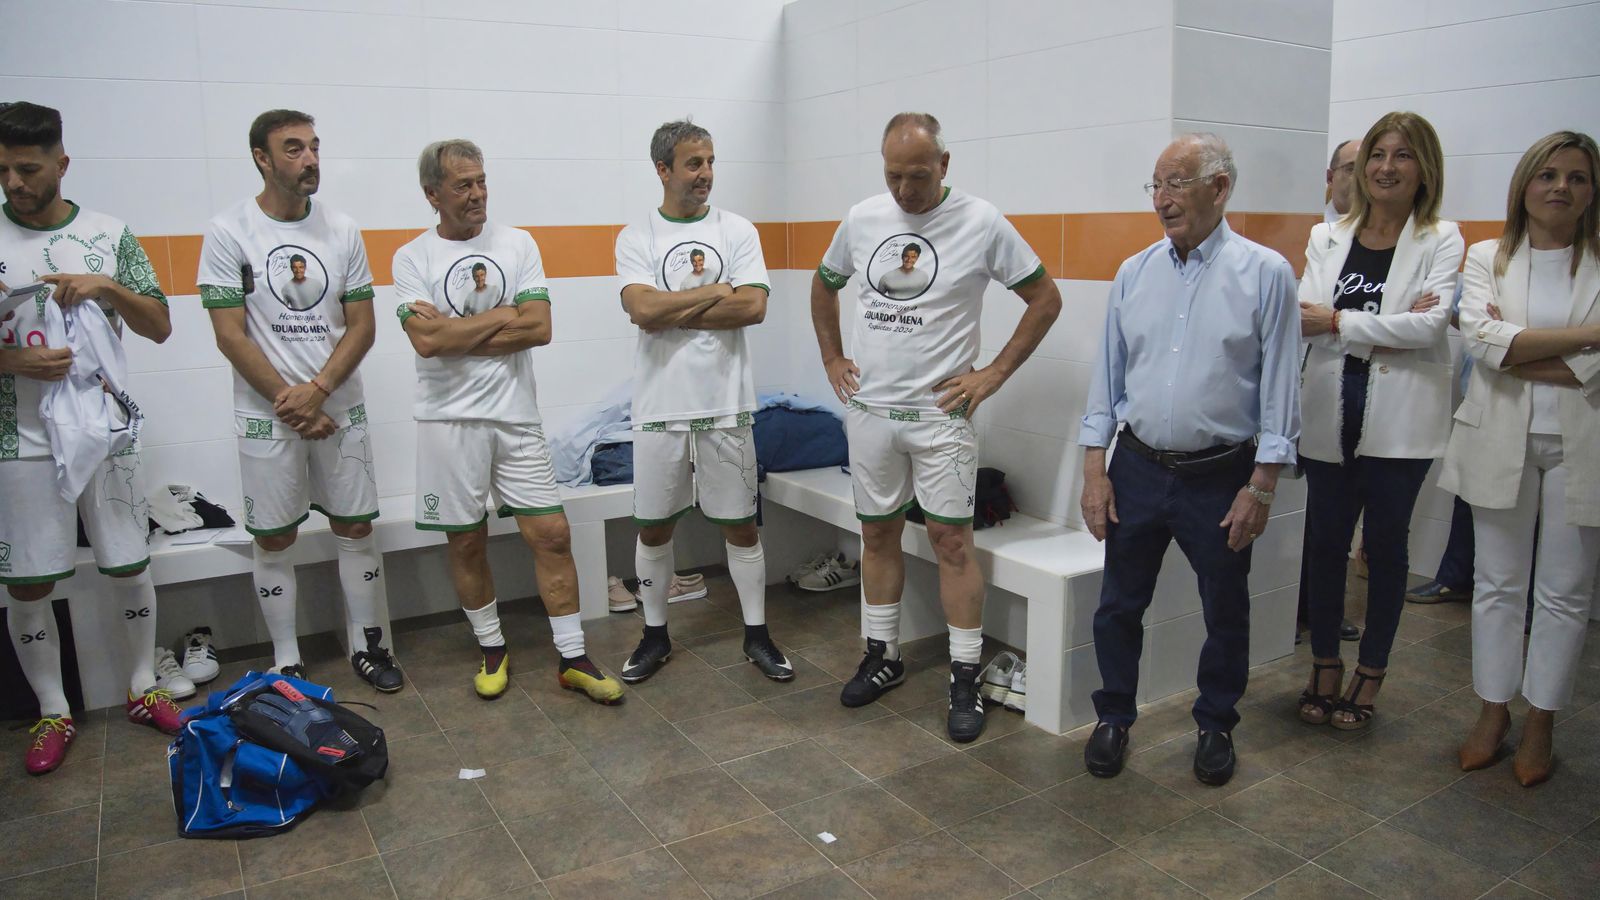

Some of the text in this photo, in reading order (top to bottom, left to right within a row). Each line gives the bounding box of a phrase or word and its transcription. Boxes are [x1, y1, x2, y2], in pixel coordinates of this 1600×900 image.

[864, 310, 924, 326] EDUARDO MENA
[271, 324, 331, 334] EDUARDO MENA
[893, 326, 914, 334] 2024
